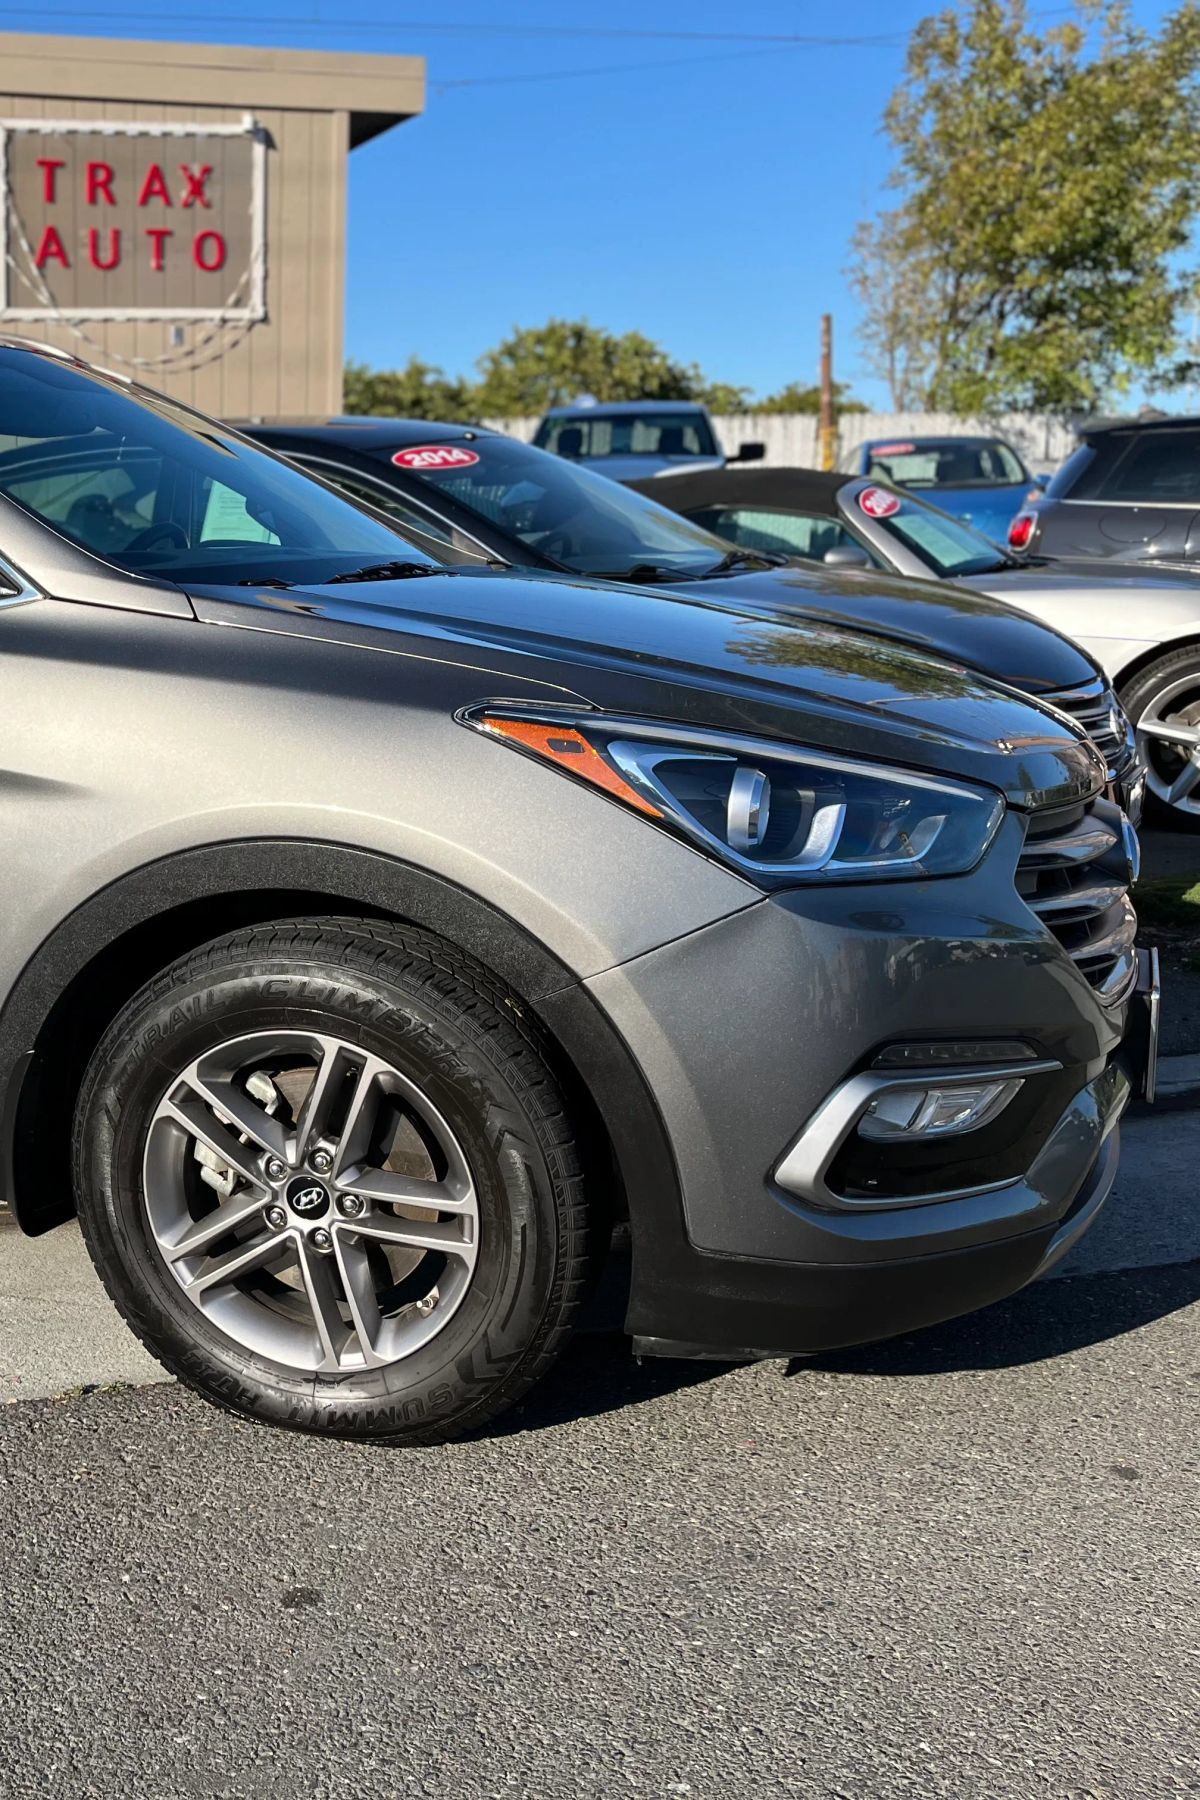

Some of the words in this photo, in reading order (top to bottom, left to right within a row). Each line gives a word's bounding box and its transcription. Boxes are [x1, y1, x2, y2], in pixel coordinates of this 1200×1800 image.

[36, 158, 213, 209] TRAX
[35, 225, 228, 273] AUTO
[403, 448, 471, 467] 2014
